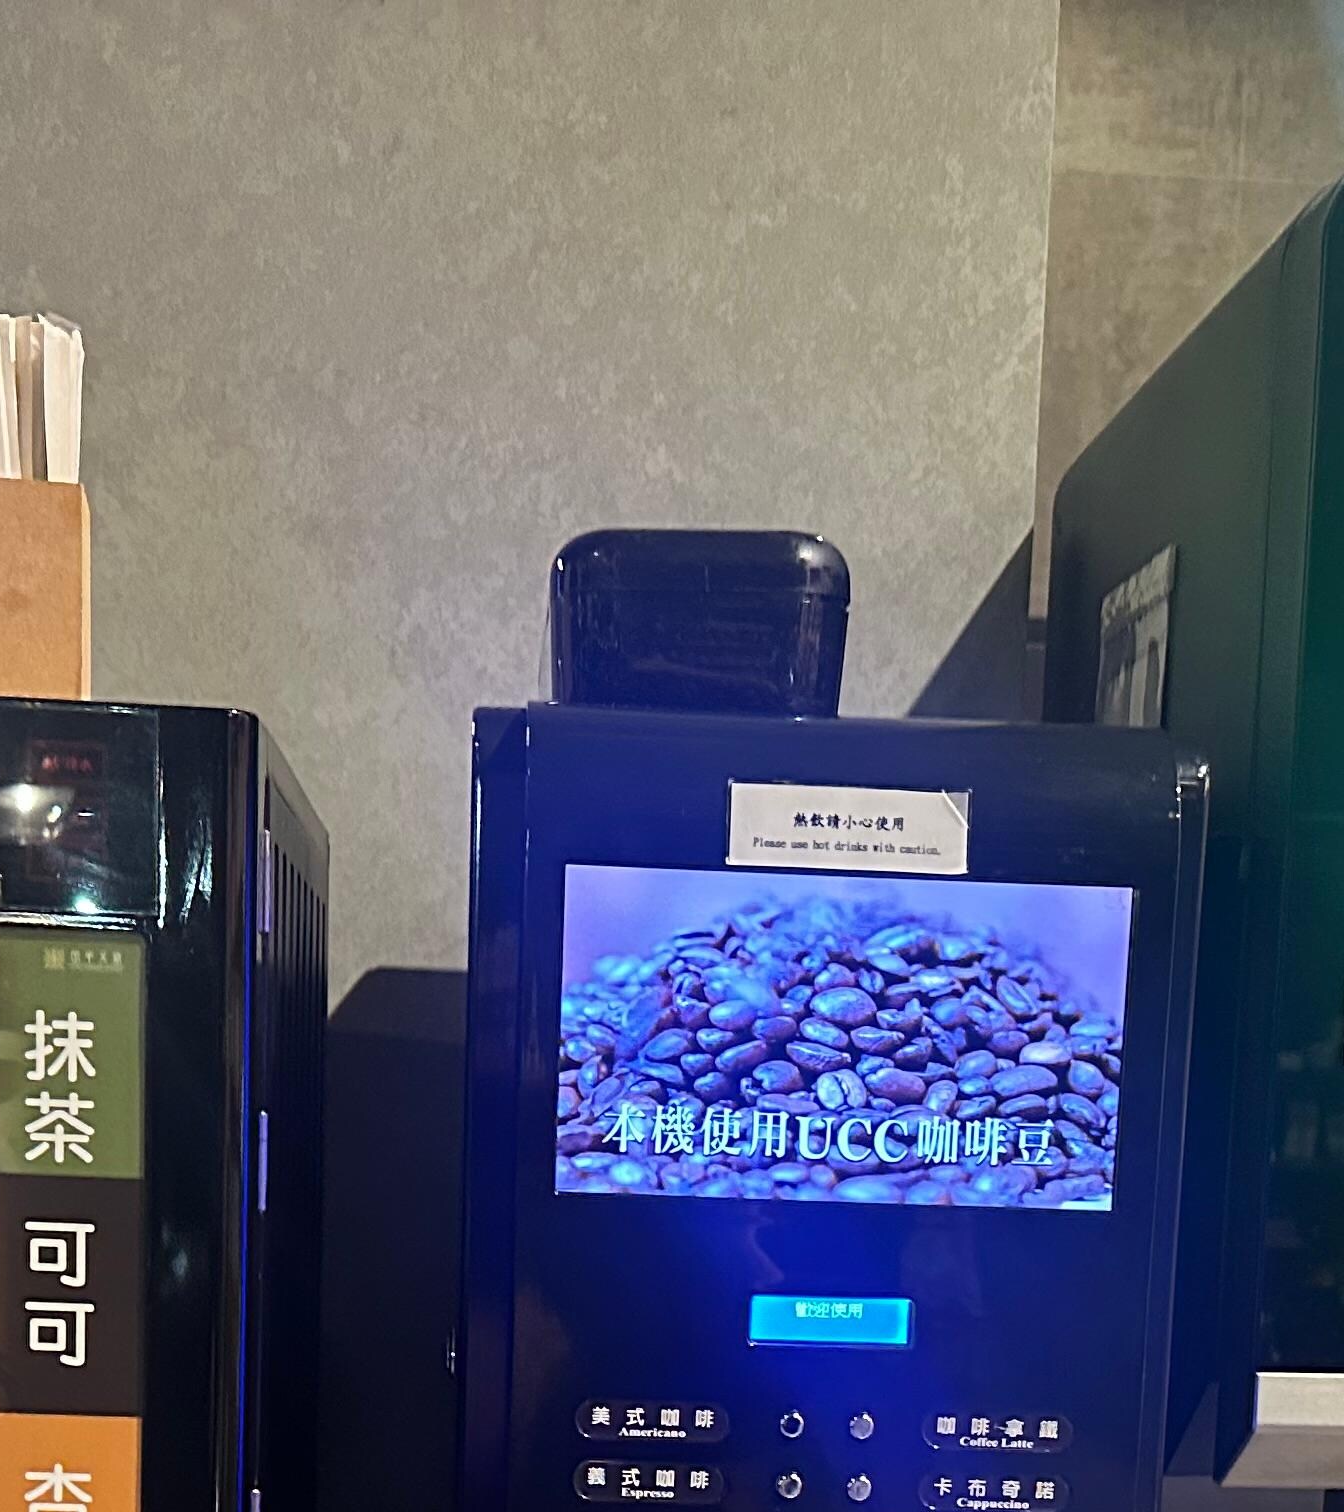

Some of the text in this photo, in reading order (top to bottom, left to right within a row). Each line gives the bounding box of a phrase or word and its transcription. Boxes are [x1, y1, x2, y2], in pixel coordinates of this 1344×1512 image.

[793, 811, 906, 833] 熱飲請小心使用
[753, 836, 787, 849] Please
[791, 840, 809, 850] use
[812, 839, 830, 851] hot
[834, 841, 869, 853] drinks
[873, 842, 896, 854] with
[23, 1009, 96, 1164] 抹茶
[602, 1102, 1055, 1167] 本機使用UCC咖啡豆
[24, 1220, 96, 1368] 可可
[795, 1301, 864, 1319] 歡迎使用
[591, 1406, 715, 1428] 美式咖啡
[936, 1416, 1058, 1439] 咖啡拿鐵
[618, 1427, 687, 1438] Americano
[959, 1436, 1035, 1449] Coffee Latte
[586, 1466, 709, 1489] 義式咖啡
[933, 1477, 1055, 1500] 卡布奇諾
[621, 1487, 675, 1500] Espresso
[956, 1497, 1030, 1511] Cappuccino
